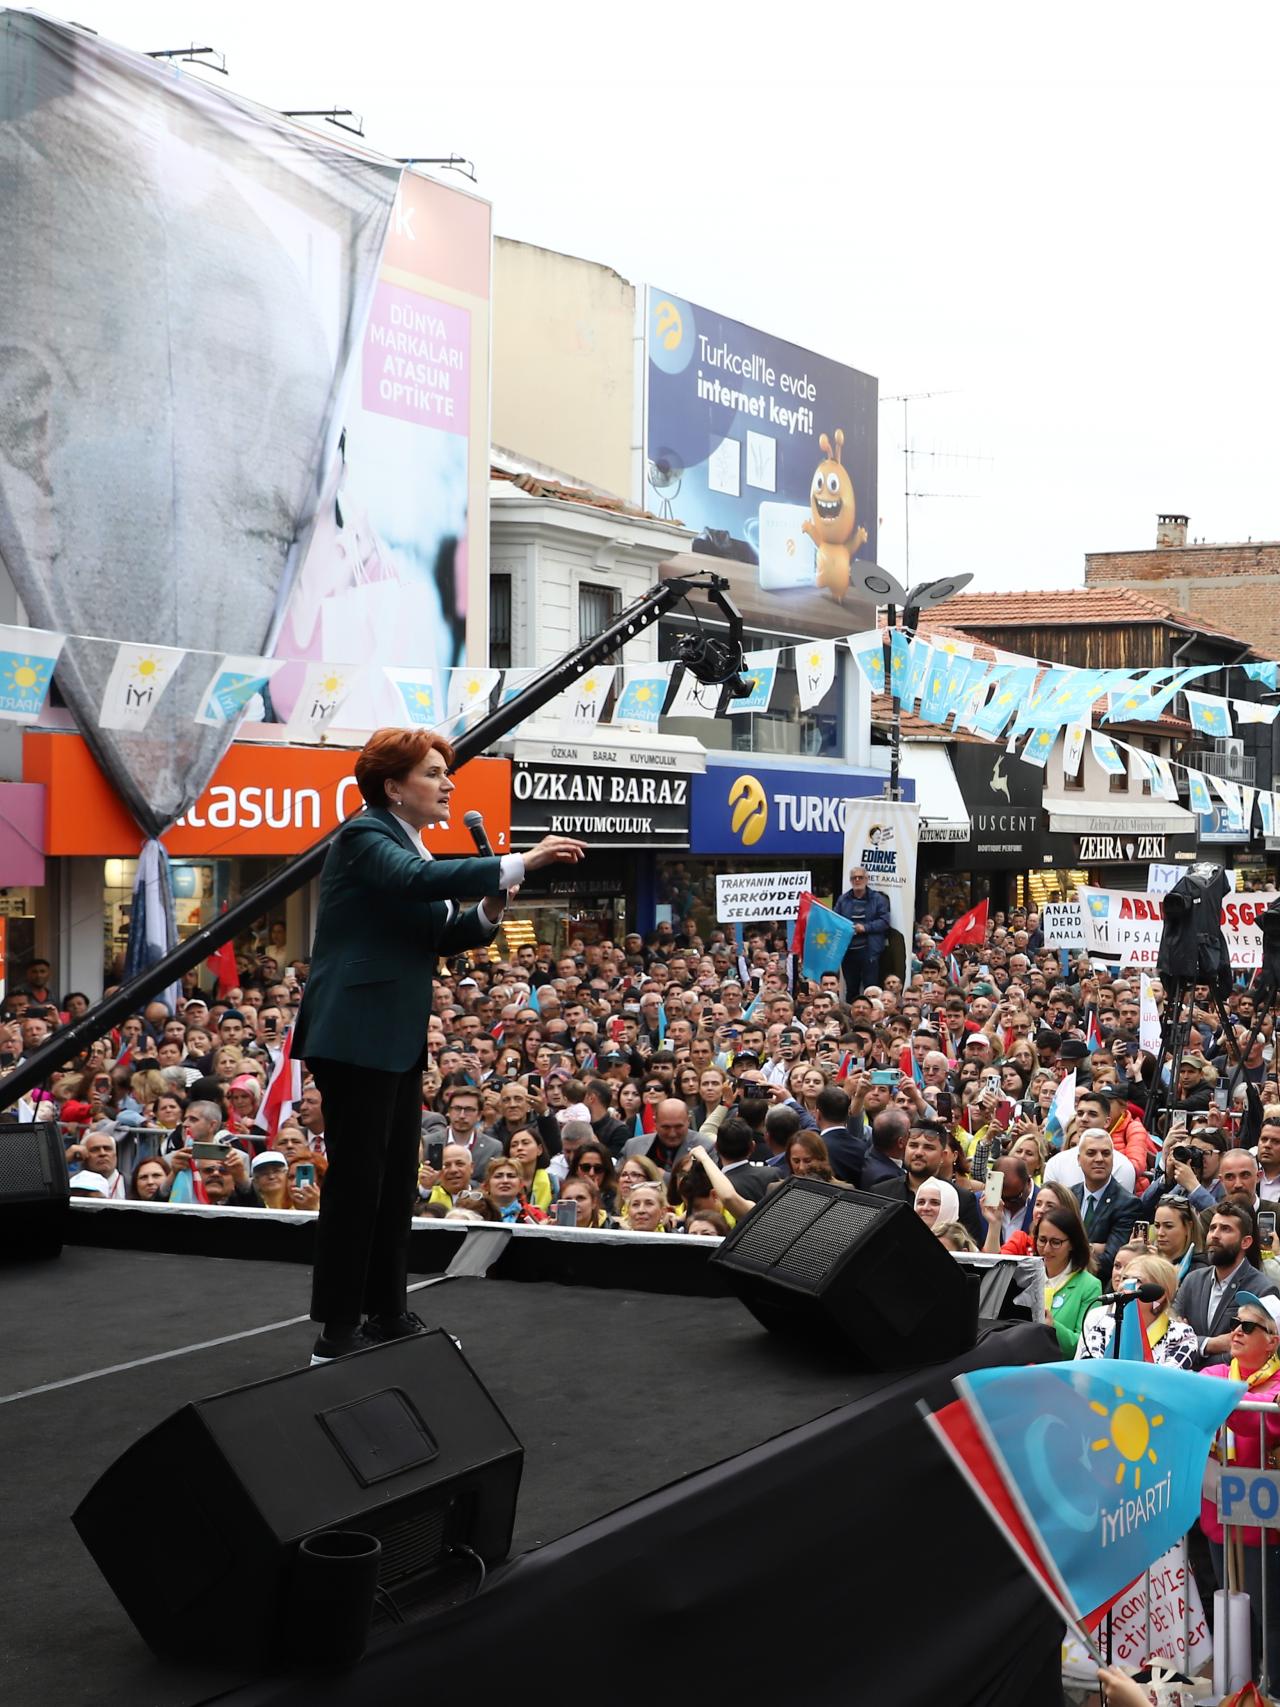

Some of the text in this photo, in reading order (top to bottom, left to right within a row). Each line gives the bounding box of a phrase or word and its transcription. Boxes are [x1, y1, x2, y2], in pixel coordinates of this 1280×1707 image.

[390, 303, 447, 341] DÜNYA
[370, 323, 463, 371] MARKALARI
[383, 354, 450, 391] ATASUN
[698, 333, 816, 402] Turkcell'le evde
[697, 370, 813, 435] internet keyfi!
[126, 684, 153, 706] İYİ
[551, 745, 676, 766] ÖZKAN BARAZ KUYUMCULUK
[513, 762, 687, 805] ÖZKAN BARAZ
[177, 784, 320, 828] tasun
[498, 831, 506, 845] 2
[551, 815, 652, 833] KUYUMCULUK
[861, 846, 897, 865] EDİRNE
[1079, 836, 1123, 860] ZEHRA
[720, 873, 809, 889] TRAKYANIN İNCİSİ
